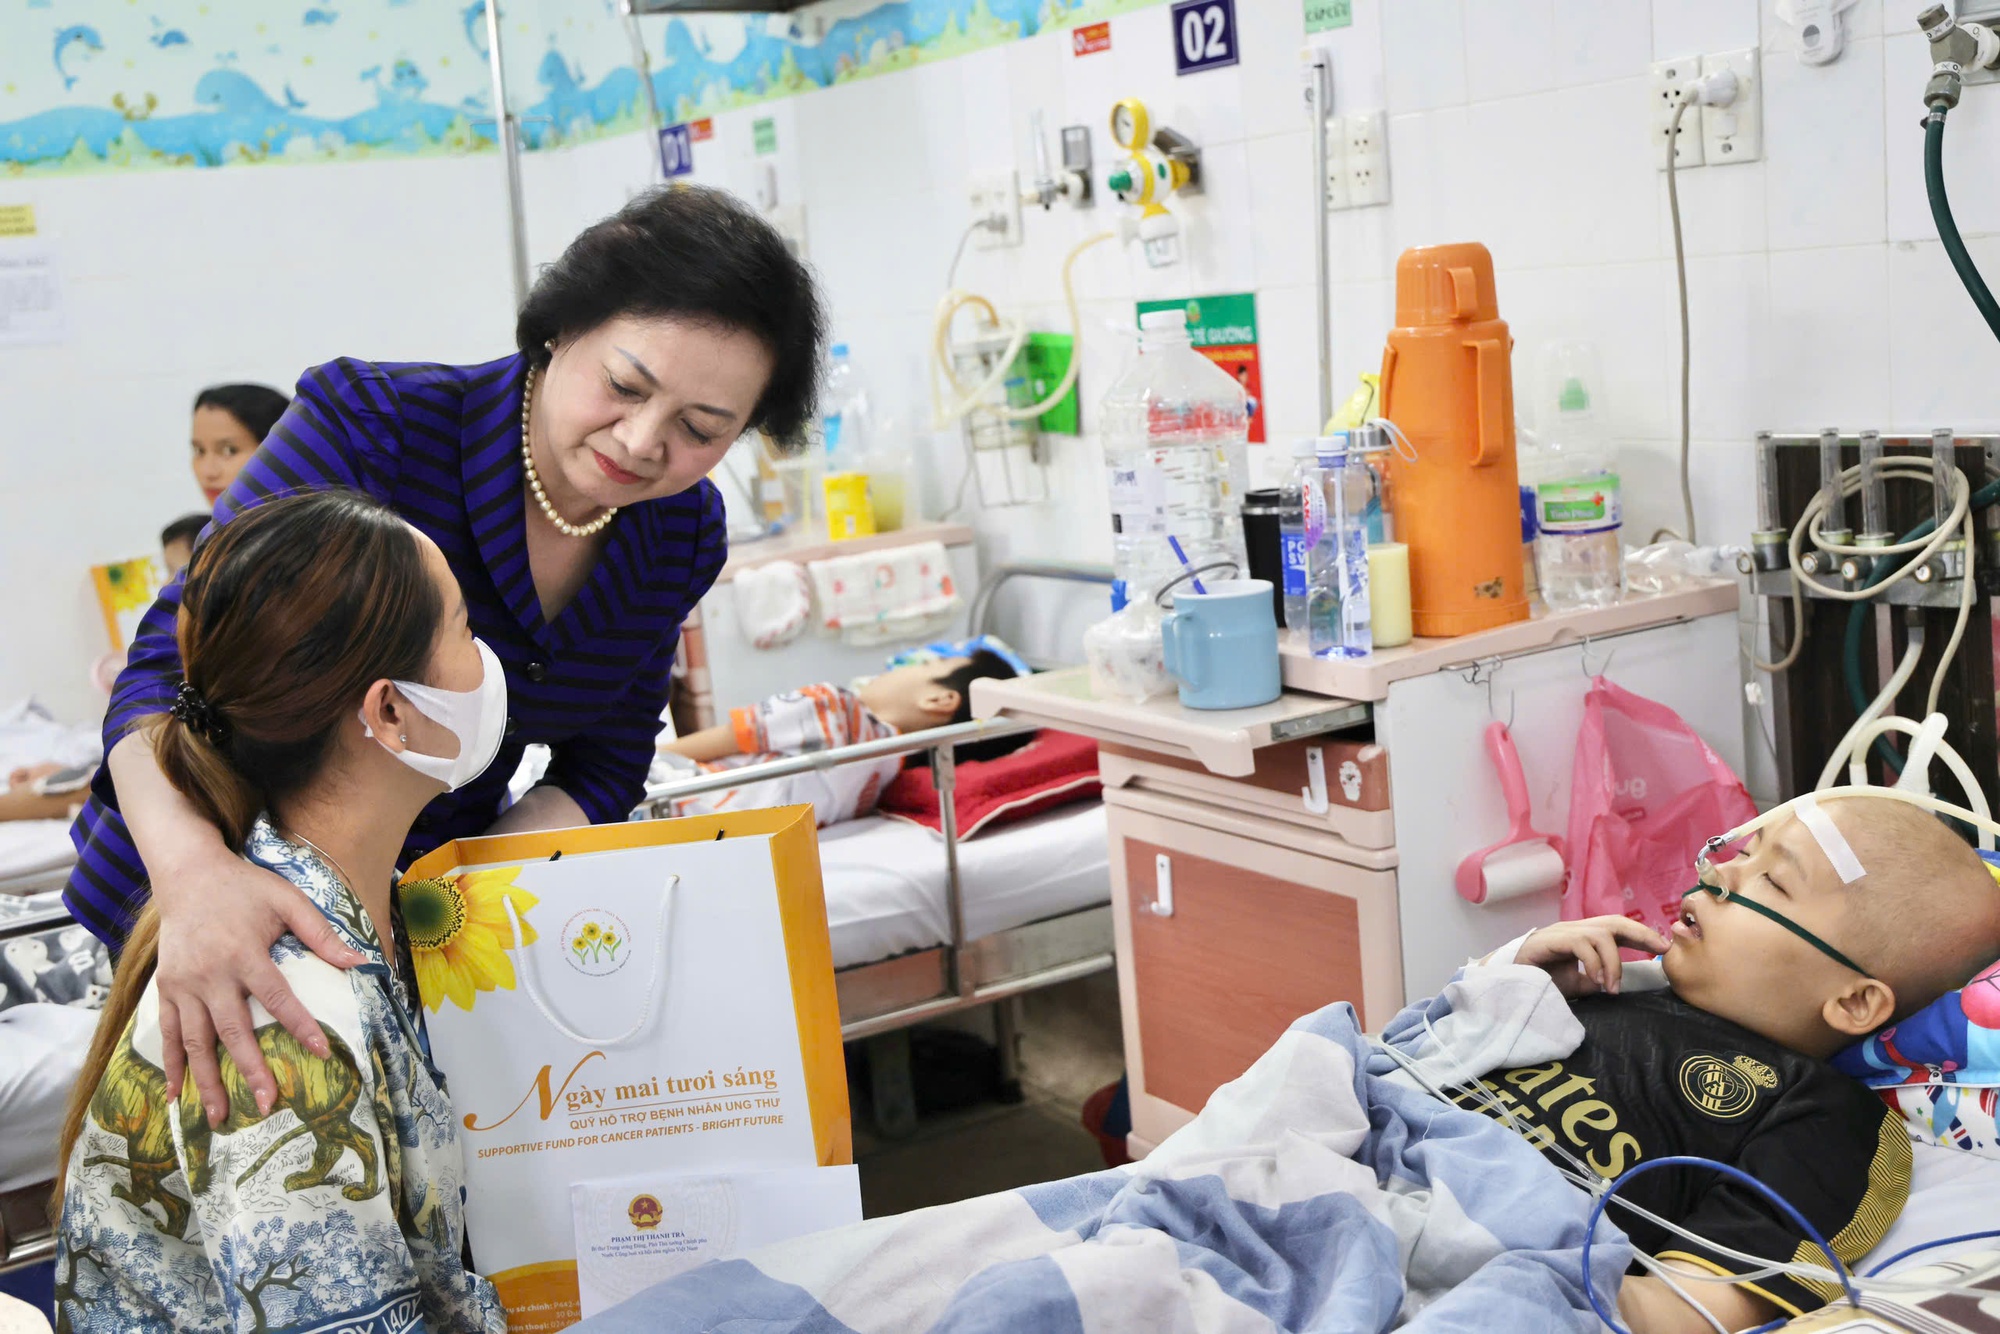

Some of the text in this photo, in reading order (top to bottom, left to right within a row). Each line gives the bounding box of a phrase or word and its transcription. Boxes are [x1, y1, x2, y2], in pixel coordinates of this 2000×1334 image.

[1182, 5, 1227, 62] 02
[662, 131, 690, 171] 01
[463, 1050, 778, 1131] Ngày mai tươi sáng
[570, 1115, 595, 1130] QUỸ
[620, 1111, 647, 1124] TRỢ
[650, 1107, 684, 1121] BỆNH
[687, 1102, 722, 1116] NHÂN
[725, 1099, 752, 1111] UNG
[754, 1097, 780, 1109] THƯ
[1504, 1061, 1642, 1179] ates
[478, 1141, 543, 1158] SUPPORTIVE
[545, 1137, 575, 1149] FUND
[577, 1134, 599, 1146] FOR
[601, 1129, 643, 1144] CANCER
[645, 1123, 694, 1138] PATIENTS
[702, 1117, 741, 1131] BRIGHT
[743, 1114, 784, 1127] FUTURE
[611, 1235, 631, 1243] PHẠM
[646, 1232, 670, 1240] THANH
